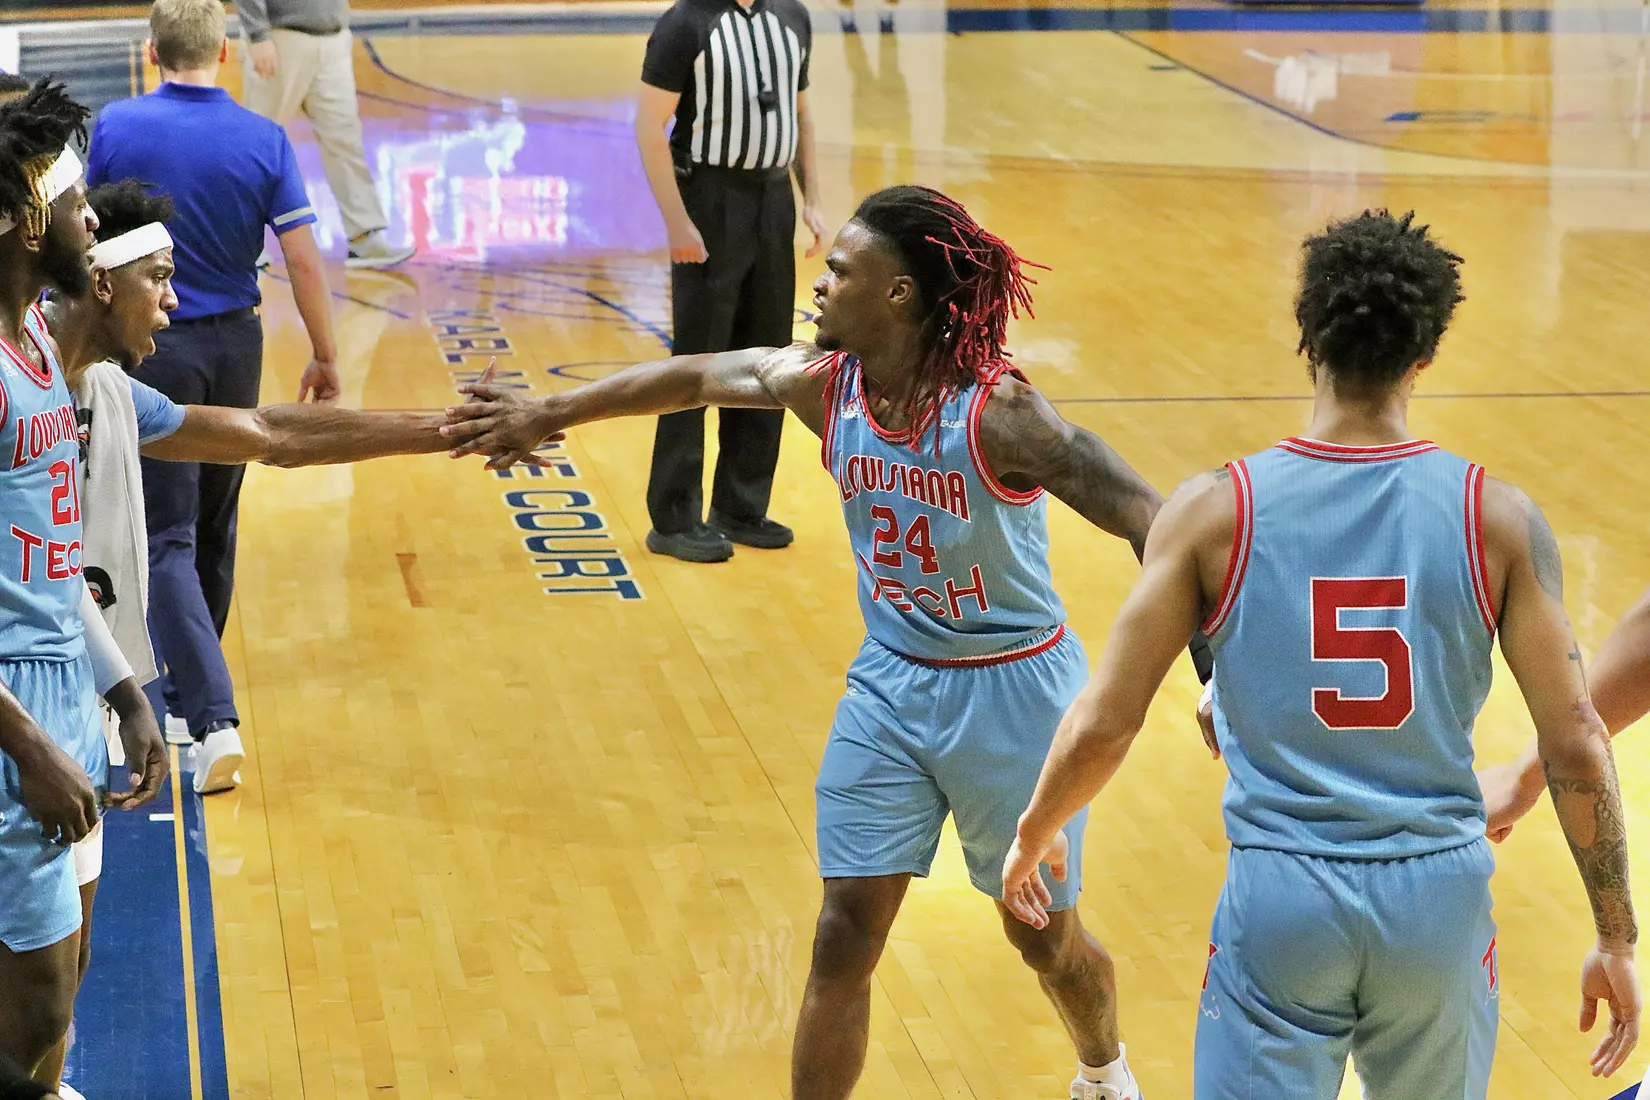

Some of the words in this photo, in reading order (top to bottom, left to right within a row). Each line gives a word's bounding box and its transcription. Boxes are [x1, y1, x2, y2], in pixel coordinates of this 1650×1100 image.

[48, 457, 80, 526] 21
[838, 452, 971, 523] LOUISIANA
[10, 523, 83, 584] TEC
[502, 489, 646, 602] COURT
[870, 503, 940, 575] 24
[1310, 576, 1415, 730] 5
